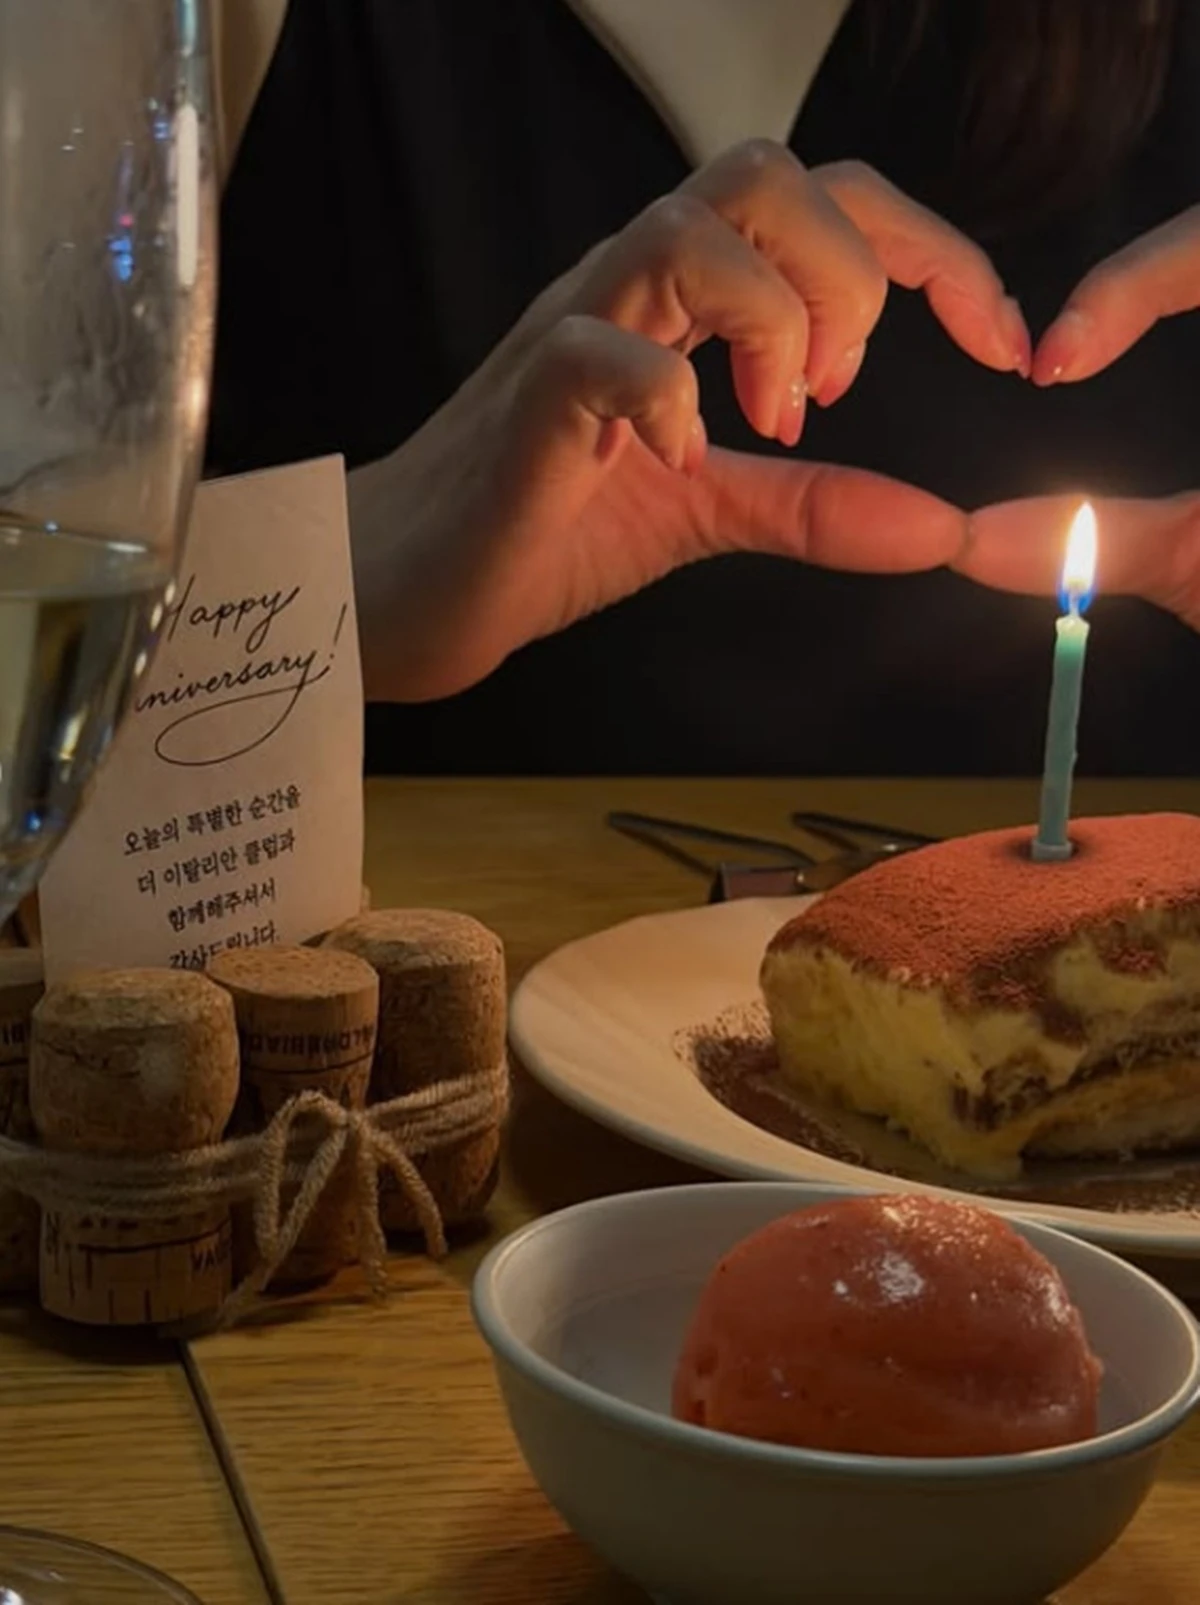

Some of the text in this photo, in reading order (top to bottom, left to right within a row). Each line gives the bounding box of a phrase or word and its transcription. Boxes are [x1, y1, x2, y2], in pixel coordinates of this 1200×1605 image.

[124, 784, 301, 856] 오늘의 특별한 순간을
[137, 827, 296, 896] 더 이탈리안 클럽과
[168, 876, 276, 933] 함께해주셔서
